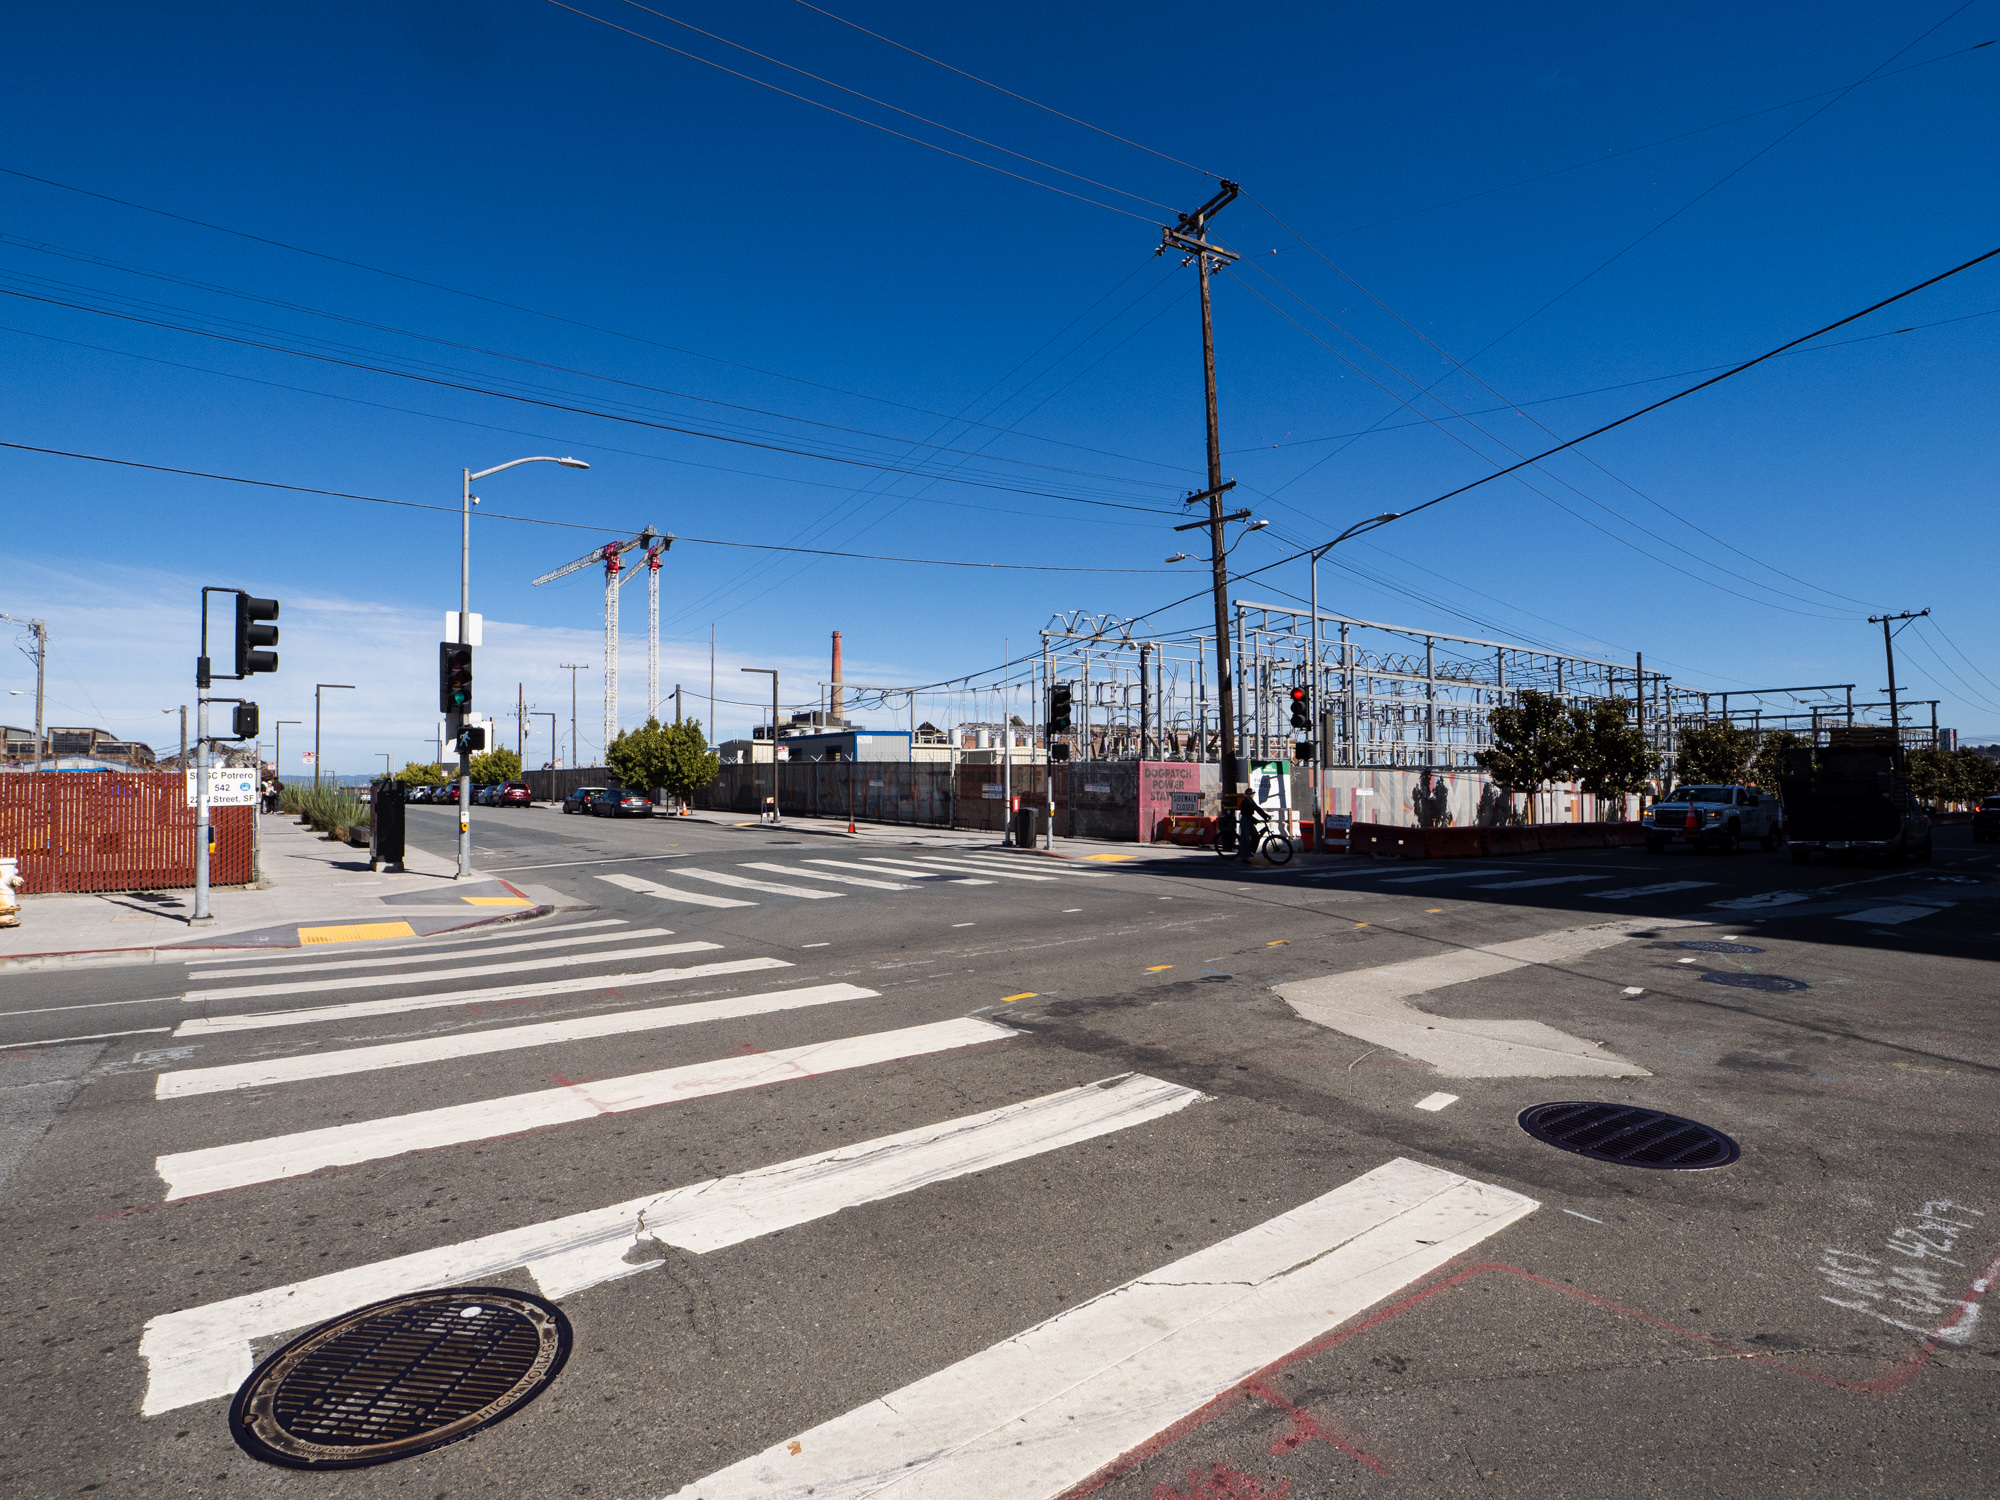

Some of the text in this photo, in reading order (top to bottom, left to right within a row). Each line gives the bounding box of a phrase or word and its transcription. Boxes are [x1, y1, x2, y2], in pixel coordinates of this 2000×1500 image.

[221, 771, 254, 779] Potrero
[1144, 768, 1192, 779] DOGPATCH
[1152, 780, 1184, 790] POWER
[243, 794, 254, 802] SF
[477, 1339, 556, 1419] HIGH VOLTAGE
